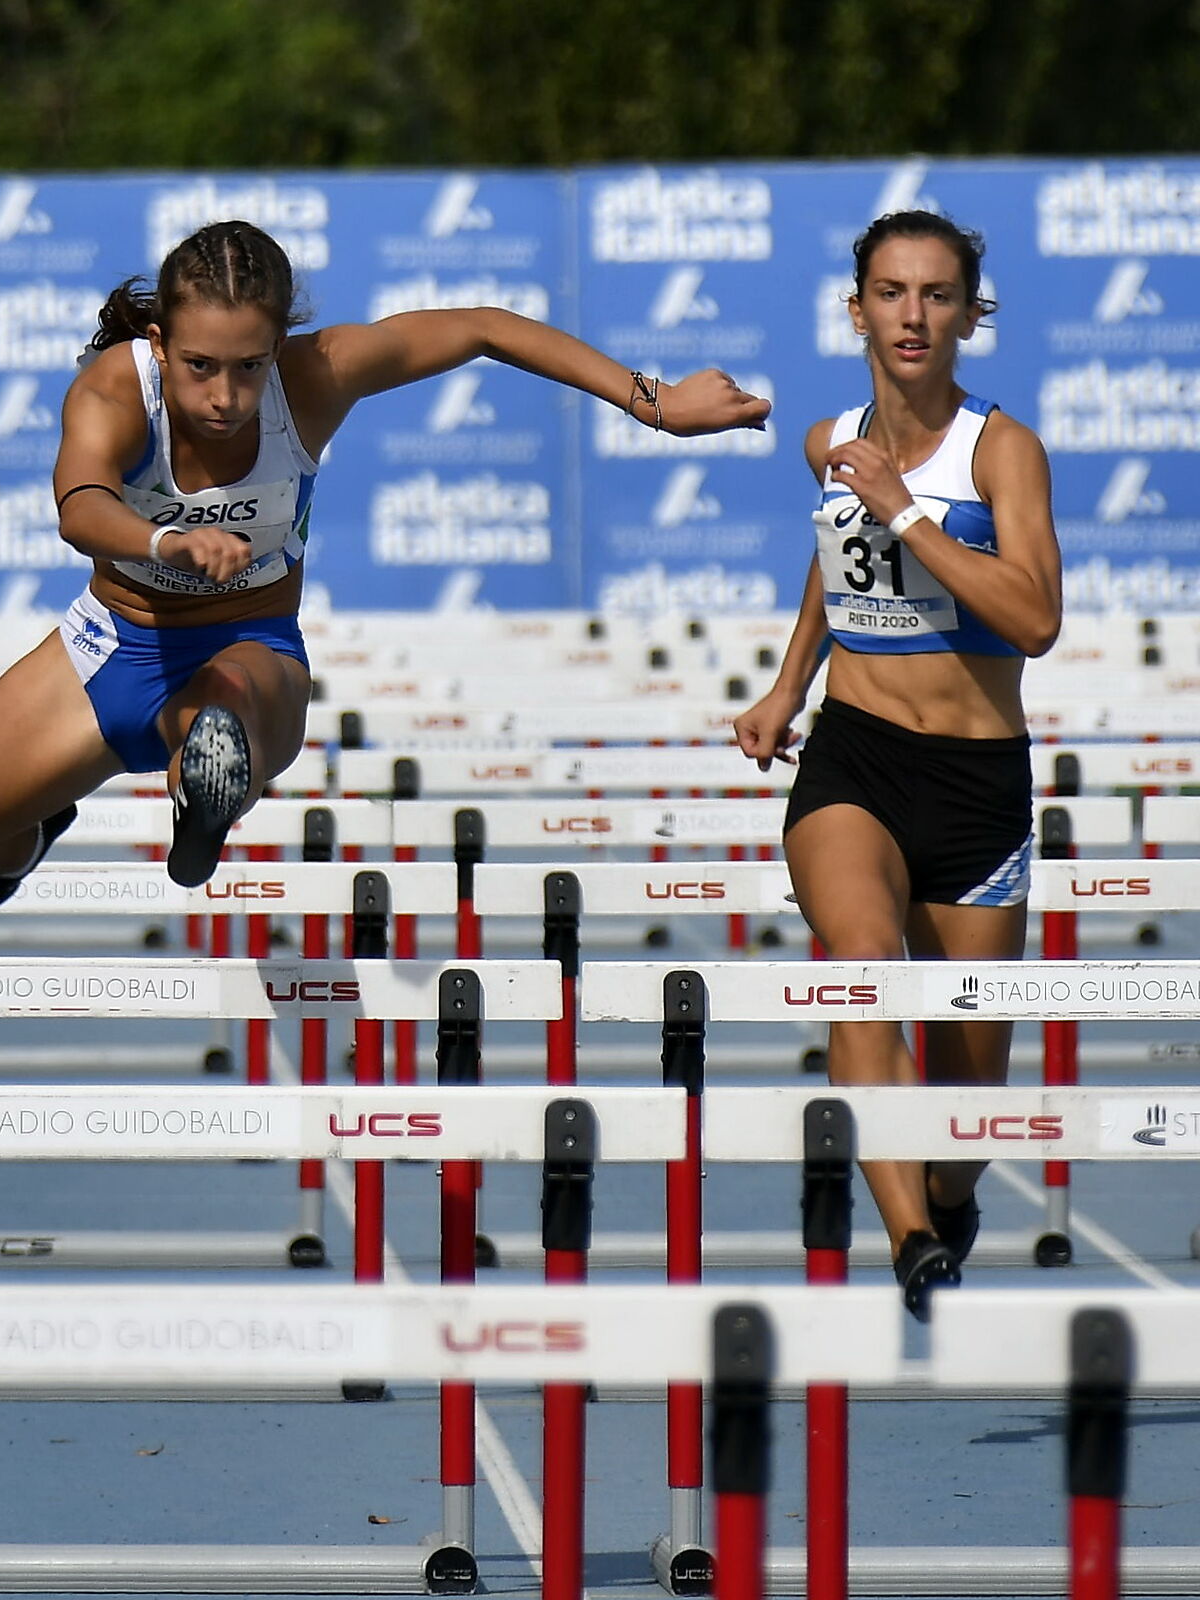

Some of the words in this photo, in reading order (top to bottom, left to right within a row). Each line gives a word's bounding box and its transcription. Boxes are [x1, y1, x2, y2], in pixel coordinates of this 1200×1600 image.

[598, 167, 772, 216] atletica
[599, 209, 772, 260] italiana
[378, 471, 550, 520] atletica
[379, 513, 550, 562] italiana
[842, 536, 906, 597] 31
[154, 574, 198, 593] RIETI
[203, 579, 250, 594] 2020
[849, 612, 877, 627] RIETI
[881, 615, 919, 628] 2020
[469, 764, 534, 781] UCS
[1131, 759, 1195, 776] UCS
[542, 817, 614, 833] UCS
[35, 880, 166, 900] GUIDOBALDI
[205, 881, 287, 900] UCS
[645, 882, 727, 901] UCS
[1071, 878, 1152, 897] UCS
[42, 976, 196, 1001] GUIDOBALDI
[266, 981, 360, 1001] UCS
[785, 985, 878, 1006] UCS
[983, 981, 1071, 1002] STADIO
[1079, 980, 1200, 1002] GUIDOBA
[85, 1109, 271, 1137] GUIDOBALDI
[328, 1113, 444, 1138] UCS
[950, 1115, 1065, 1141] UCS
[114, 1318, 356, 1353] GUIDOBALDI
[441, 1321, 588, 1356] UCS
